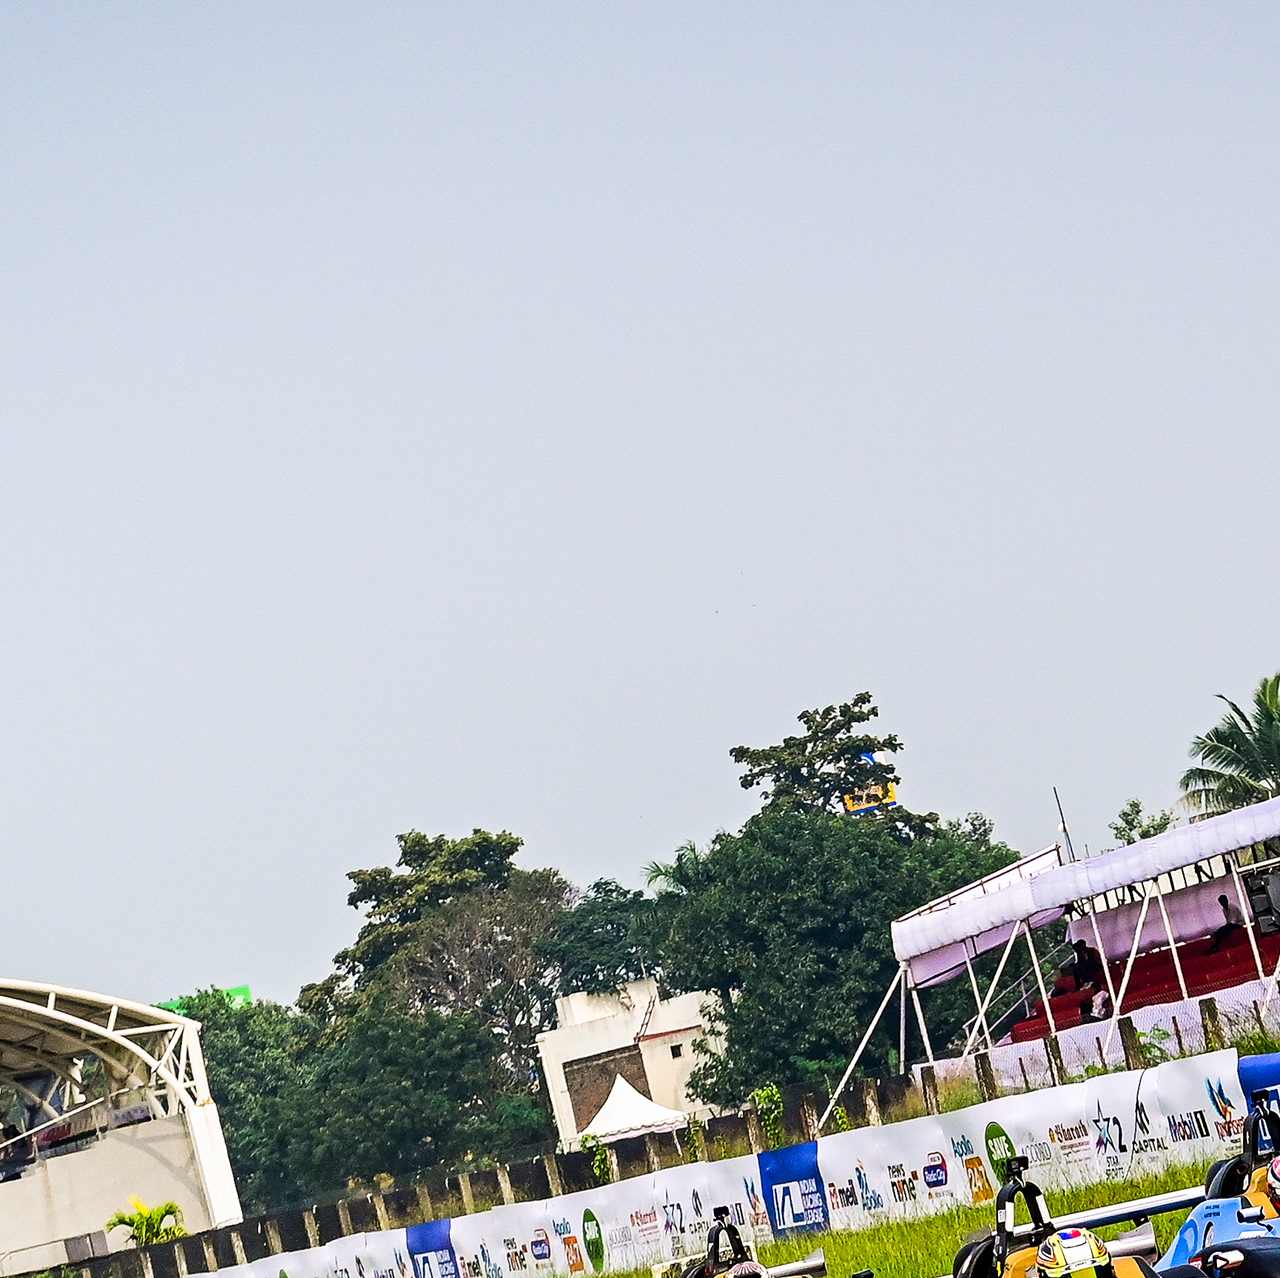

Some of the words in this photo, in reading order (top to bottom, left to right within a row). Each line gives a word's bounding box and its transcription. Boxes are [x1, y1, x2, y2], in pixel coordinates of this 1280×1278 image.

[988, 1136, 1012, 1161] SAVE
[1132, 1137, 1168, 1154] CAPITAL
[888, 1163, 905, 1179] news
